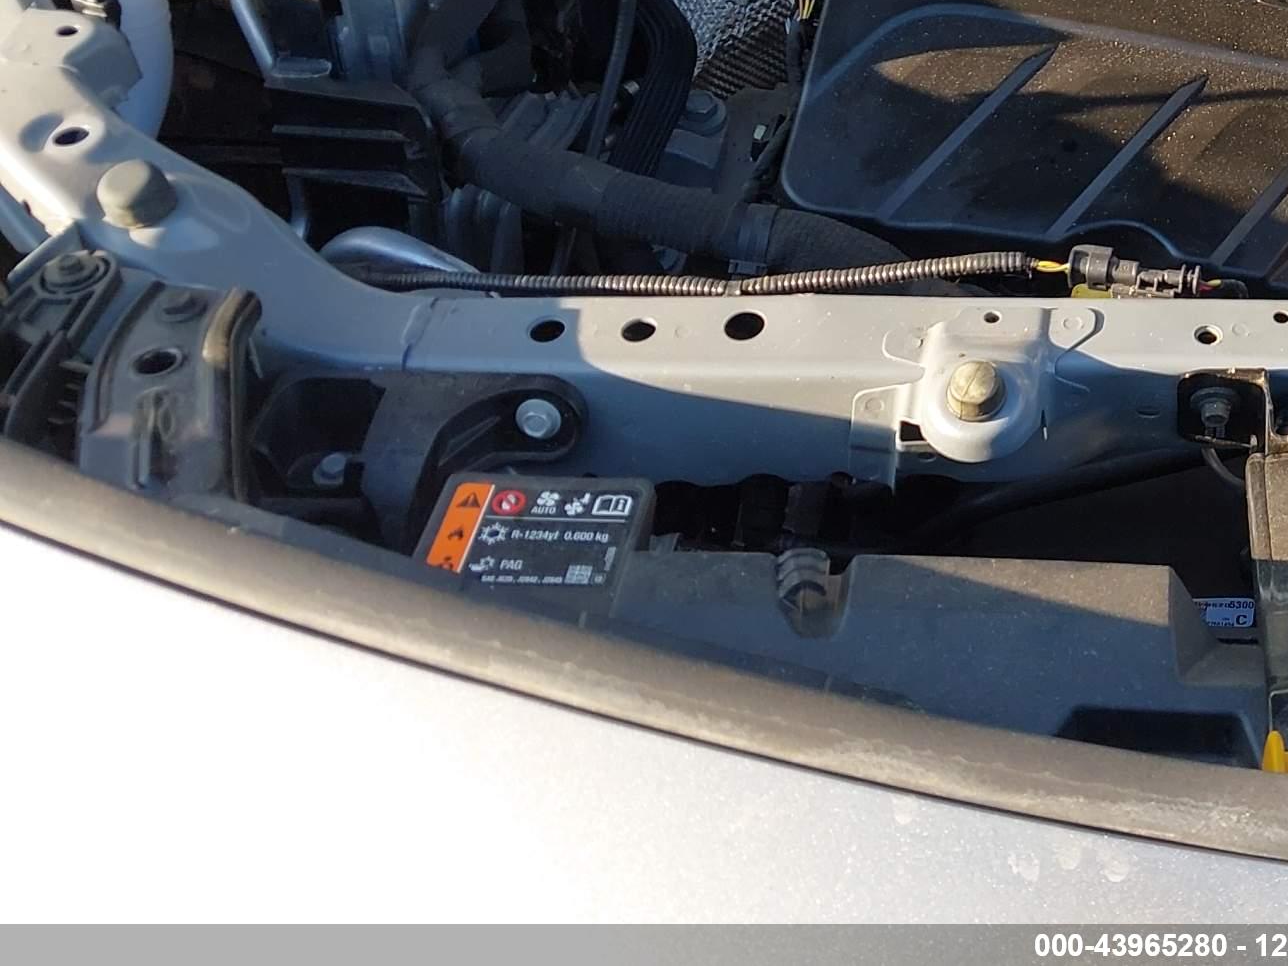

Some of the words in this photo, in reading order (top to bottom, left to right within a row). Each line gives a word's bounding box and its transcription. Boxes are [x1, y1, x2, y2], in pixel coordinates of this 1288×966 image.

[530, 506, 557, 515] AUTO
[510, 529, 560, 542] R-1234yf
[563, 531, 593, 542] 0.600
[595, 532, 609, 544] kg
